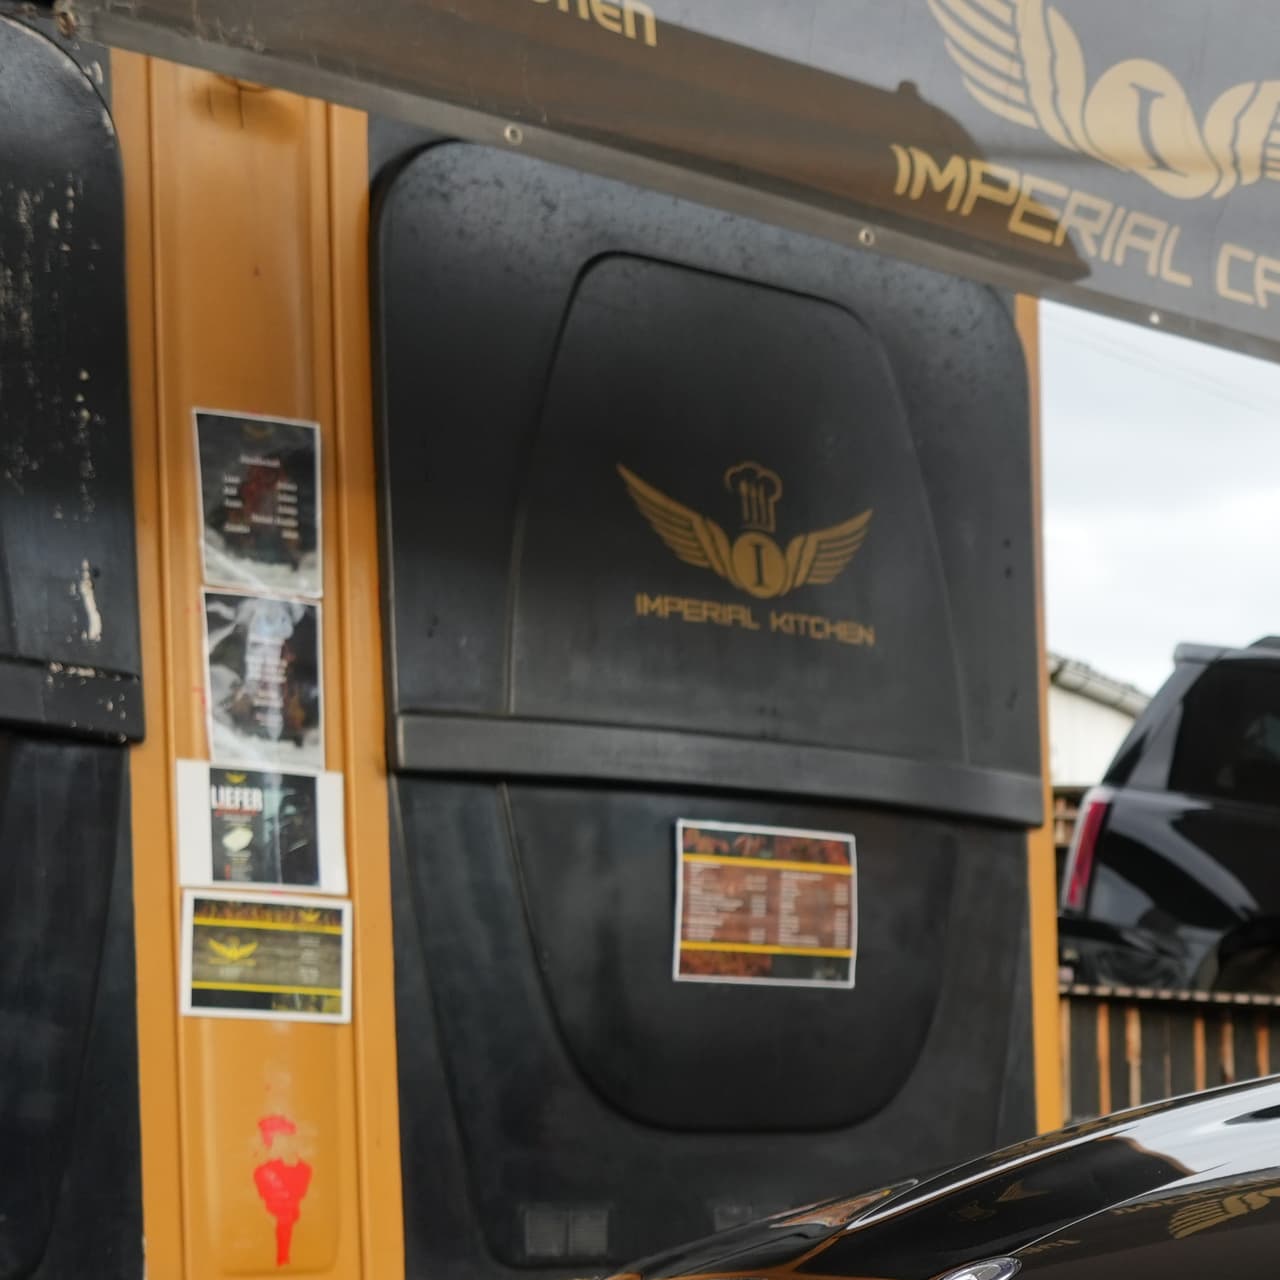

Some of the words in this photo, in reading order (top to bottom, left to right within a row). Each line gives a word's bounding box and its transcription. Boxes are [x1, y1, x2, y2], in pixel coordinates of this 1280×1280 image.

[890, 144, 1194, 288] IMPERIAL
[635, 593, 761, 630] IMPERIAL
[771, 611, 876, 647] KITCHEN
